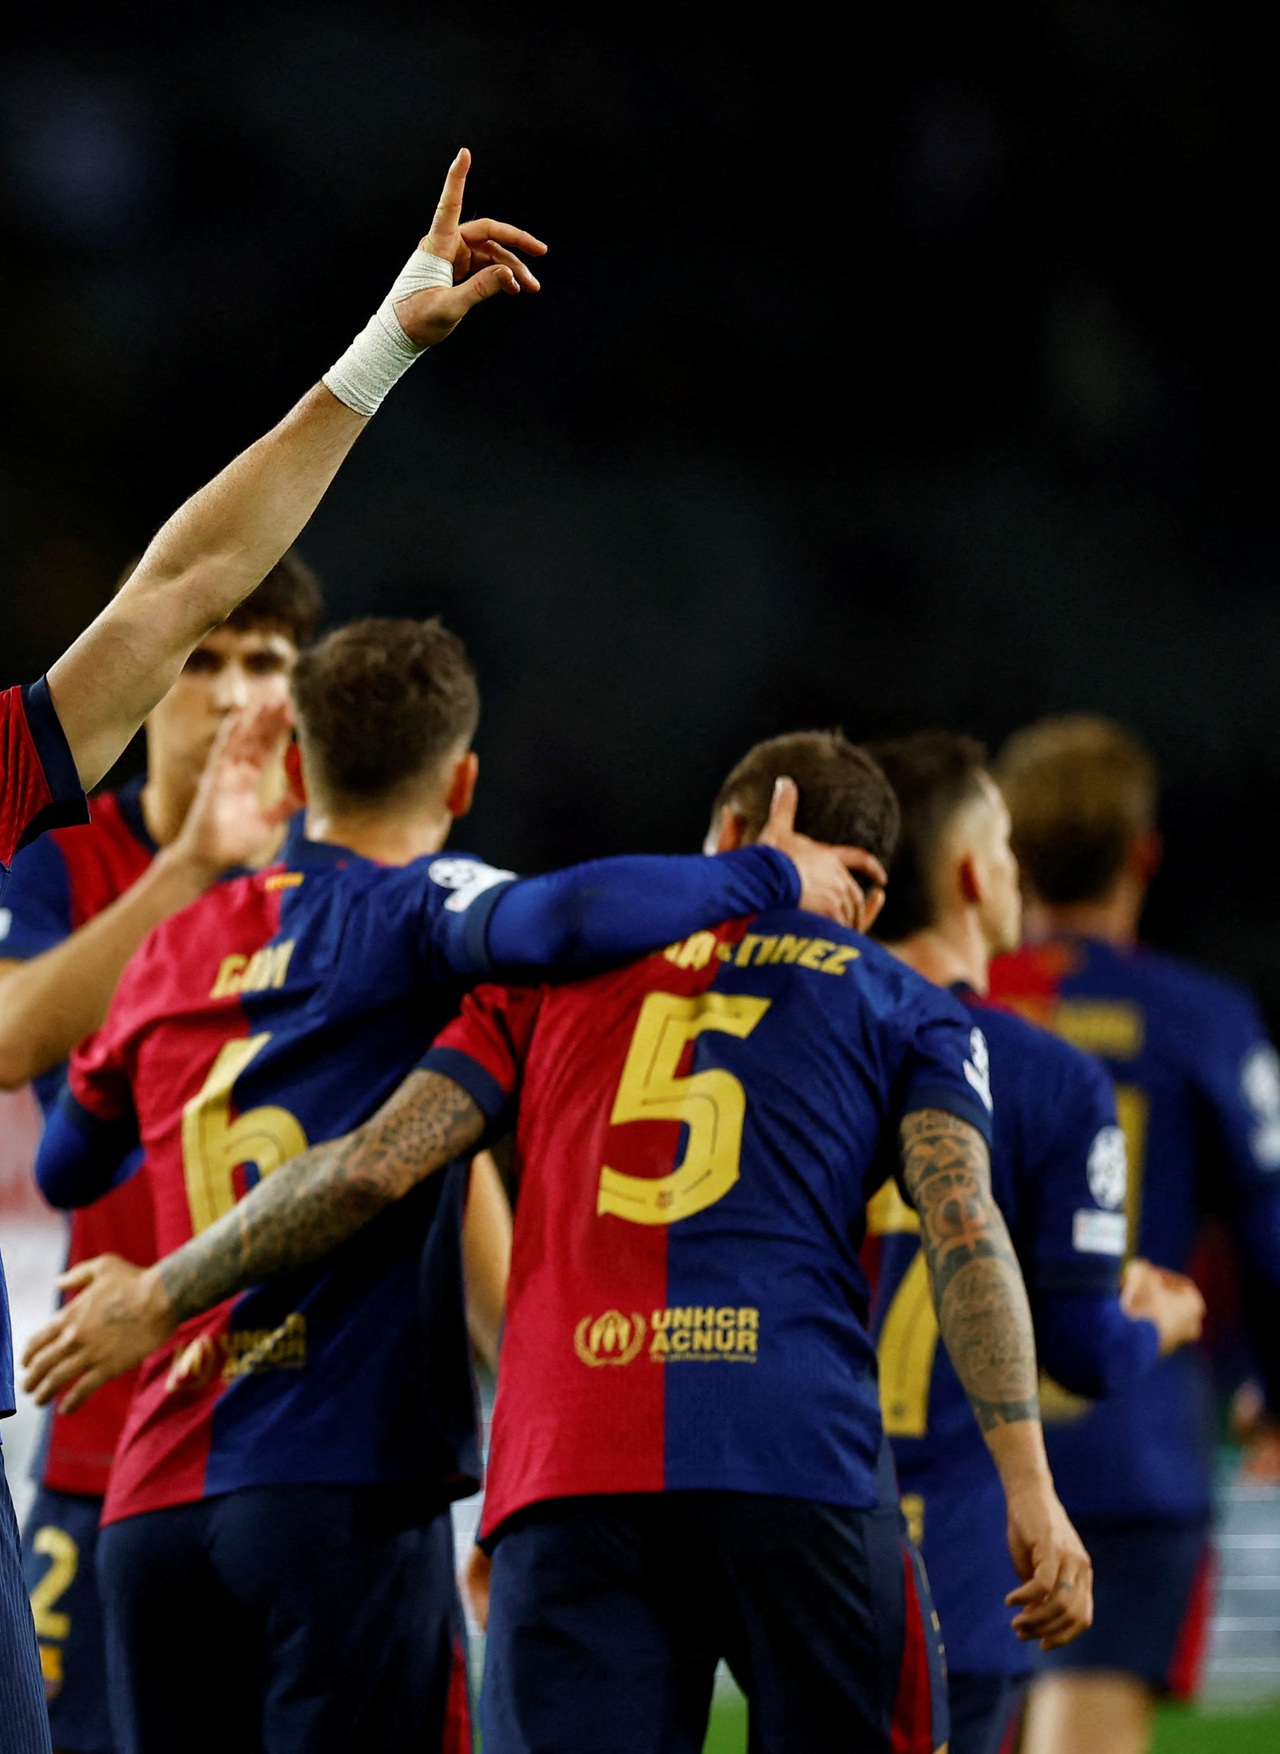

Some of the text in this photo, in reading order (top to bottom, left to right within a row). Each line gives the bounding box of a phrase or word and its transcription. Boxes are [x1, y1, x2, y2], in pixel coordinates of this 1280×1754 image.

[597, 990, 772, 1225] 5
[649, 1330, 758, 1354] ACNUR
[650, 1306, 760, 1332] UNHCR
[31, 1525, 79, 1640] 2
